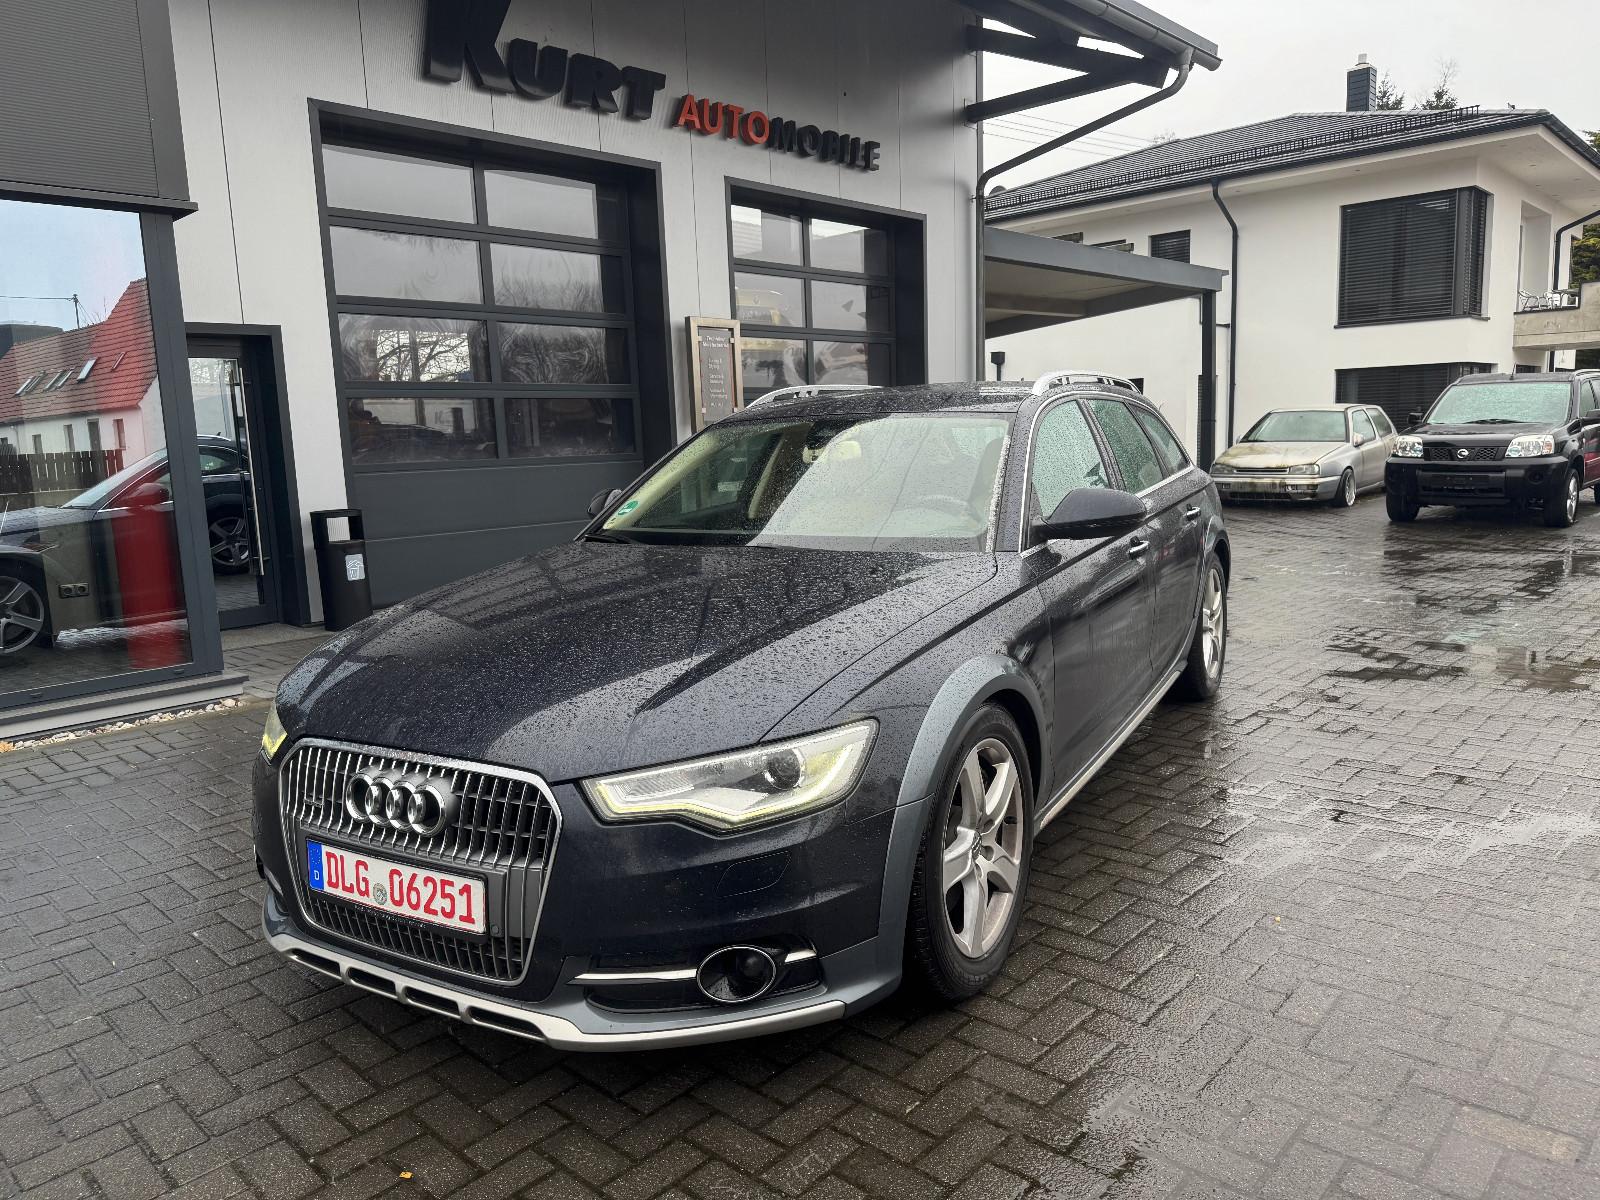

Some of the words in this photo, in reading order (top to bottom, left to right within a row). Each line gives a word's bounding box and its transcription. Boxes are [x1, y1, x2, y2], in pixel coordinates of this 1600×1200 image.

[674, 93, 882, 171] AUTOMOBILE
[313, 869, 320, 881] D
[325, 851, 371, 899] DLG
[388, 868, 477, 925] 06251
